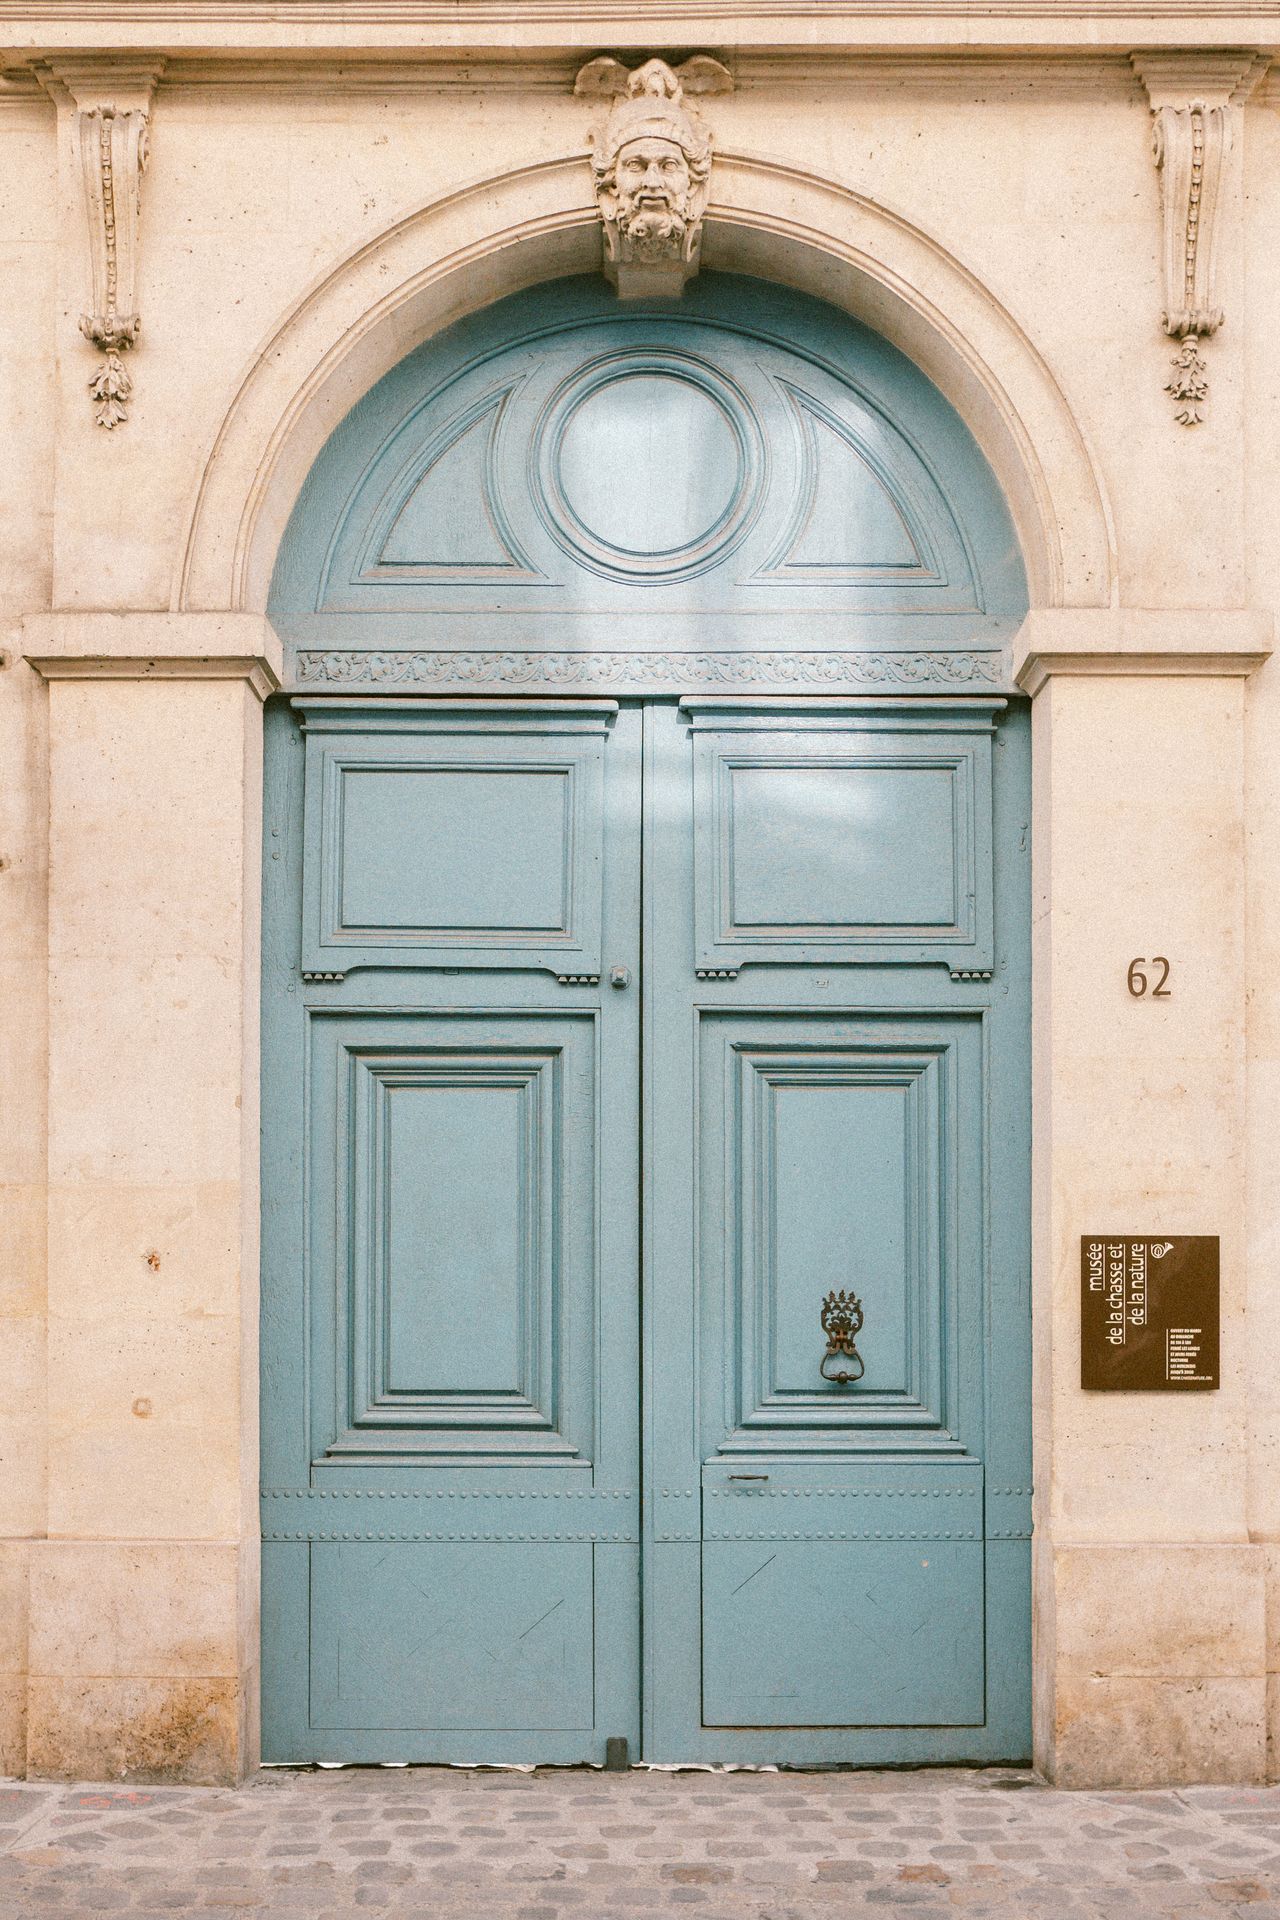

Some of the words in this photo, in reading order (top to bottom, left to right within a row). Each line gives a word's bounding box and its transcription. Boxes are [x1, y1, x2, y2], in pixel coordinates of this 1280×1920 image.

[1127, 956, 1171, 998] 62
[1107, 1243, 1122, 1259] et
[1086, 1243, 1102, 1291] musée
[1129, 1243, 1144, 1289] nature
[1105, 1262, 1122, 1308] chasse
[1126, 1293, 1144, 1305] la
[1105, 1311, 1122, 1324] la
[1126, 1308, 1144, 1325] de
[1105, 1328, 1122, 1345] de
